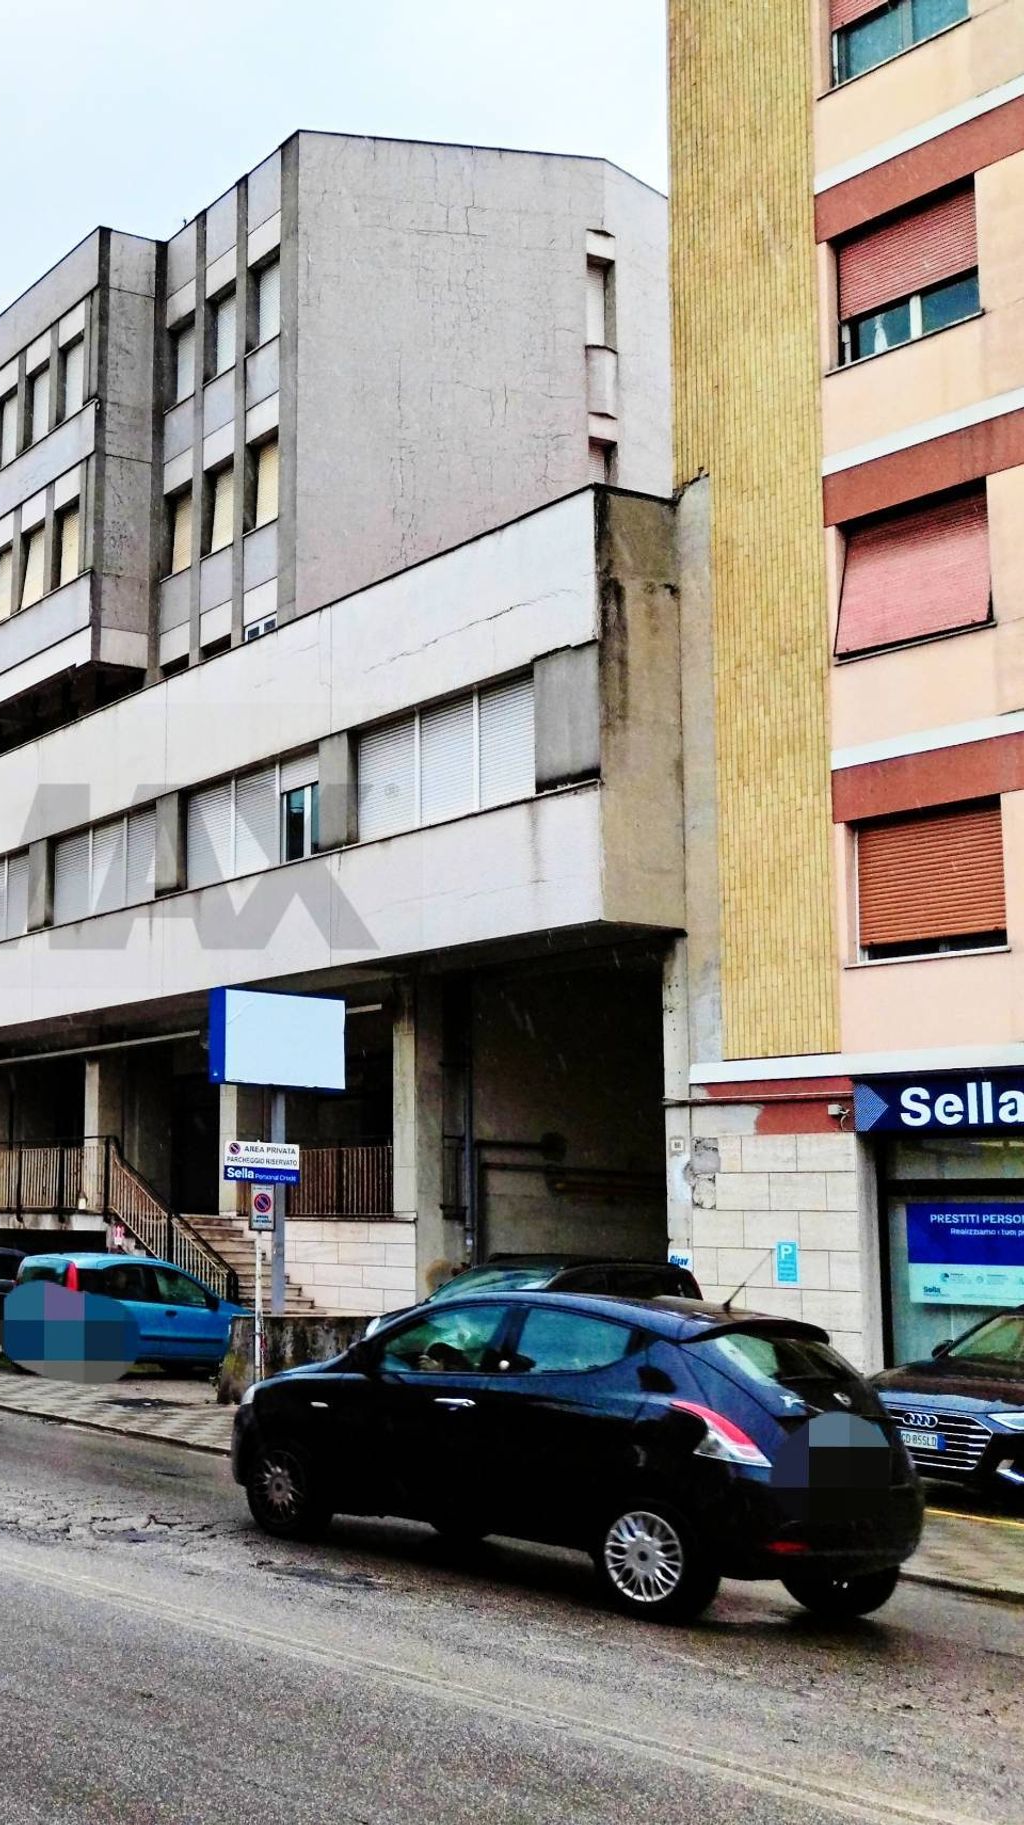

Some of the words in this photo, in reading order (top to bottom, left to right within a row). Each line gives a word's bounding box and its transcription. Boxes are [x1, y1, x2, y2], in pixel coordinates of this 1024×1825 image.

[900, 1081, 1024, 1127] Sella
[244, 1145, 265, 1153] AREA
[266, 1147, 296, 1155] PRIVATA
[226, 1156, 265, 1164] PARCHEGGIO
[266, 1158, 298, 1167] RISERVATO
[226, 1167, 255, 1179] Sella
[929, 1213, 980, 1224] PRESTITI
[950, 1227, 996, 1236] Realizziamo
[1001, 1228, 1017, 1236] tuoi
[780, 1244, 793, 1260] P
